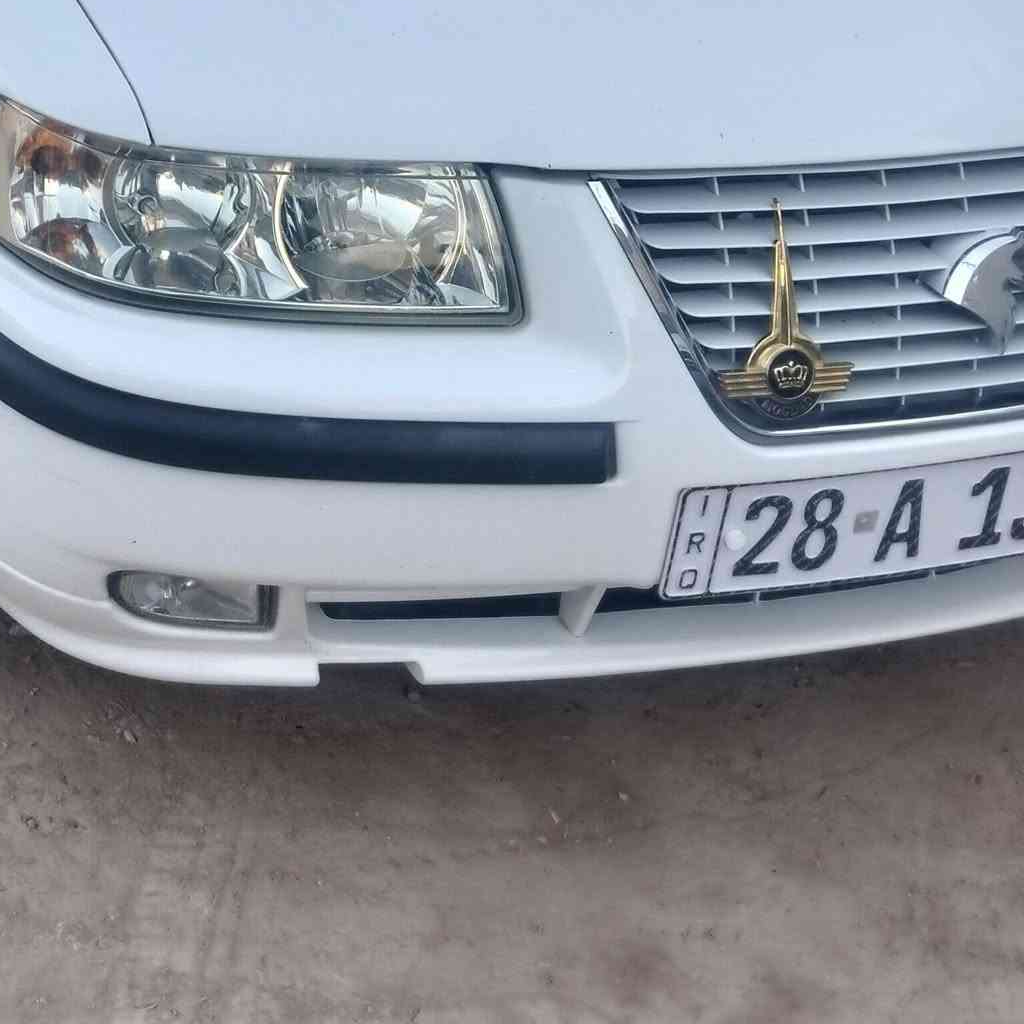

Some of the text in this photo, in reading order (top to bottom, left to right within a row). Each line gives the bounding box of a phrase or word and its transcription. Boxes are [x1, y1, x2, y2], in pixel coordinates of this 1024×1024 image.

[732, 466, 1024, 577] 28 A 1
